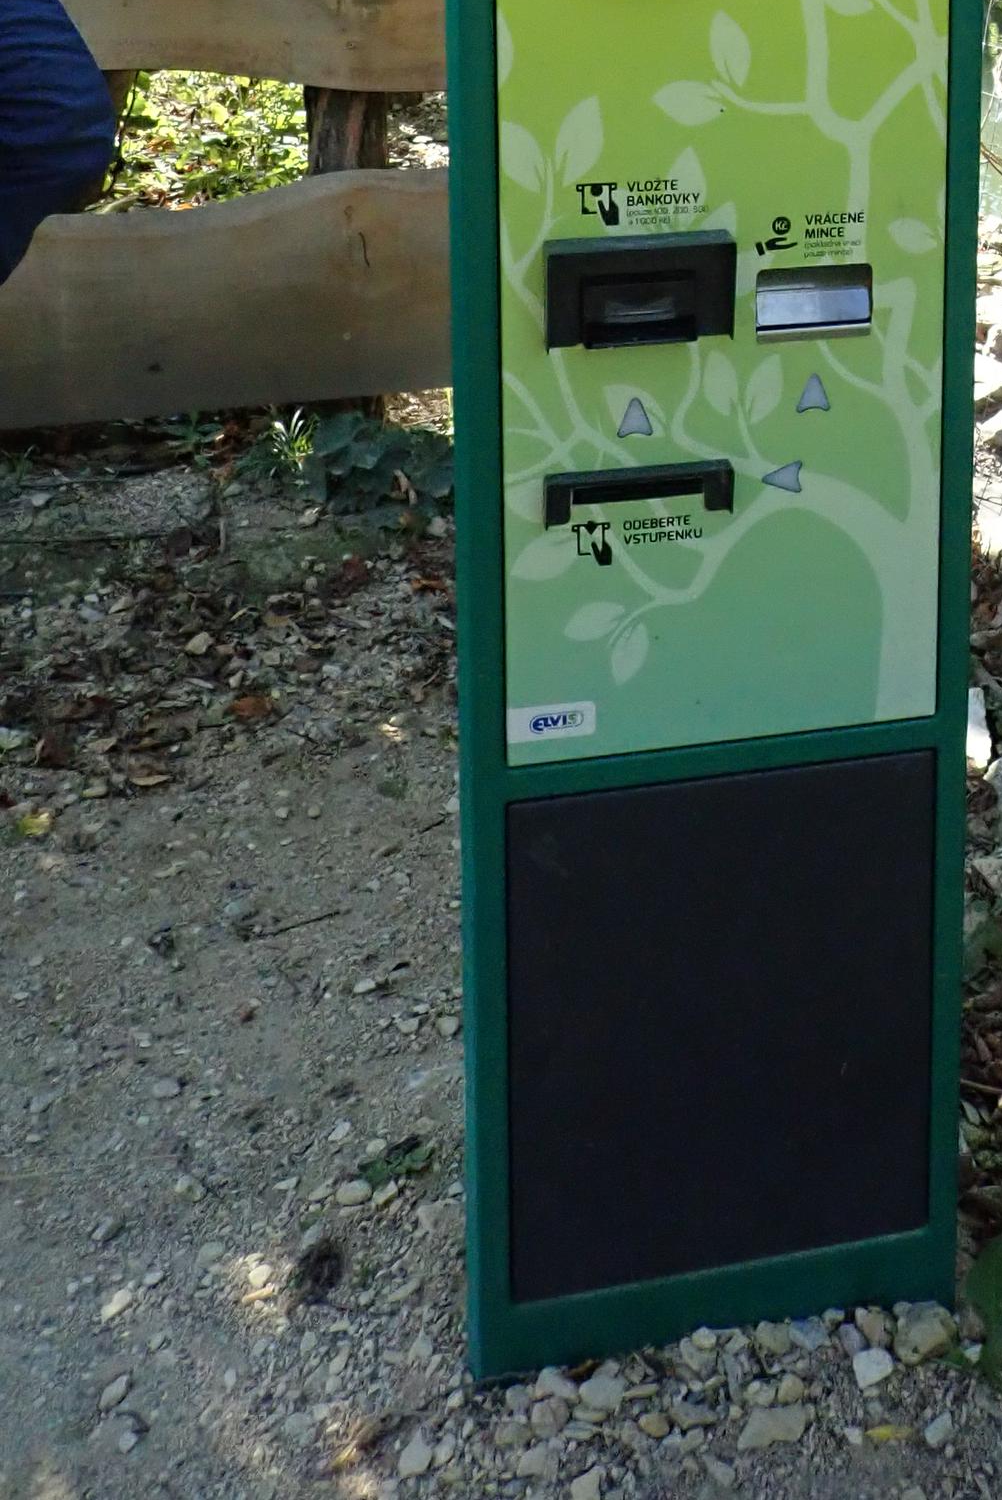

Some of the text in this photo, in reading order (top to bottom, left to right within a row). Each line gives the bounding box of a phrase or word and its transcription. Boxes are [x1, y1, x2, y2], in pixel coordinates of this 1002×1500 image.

[627, 177, 678, 192] VLOŽTE
[626, 192, 700, 206] BANKOVKY
[805, 209, 865, 225] VRÁCENÉ
[805, 227, 844, 239] MINCE
[623, 514, 691, 530] ODEBERTE
[624, 527, 703, 544] VSTUPENKU
